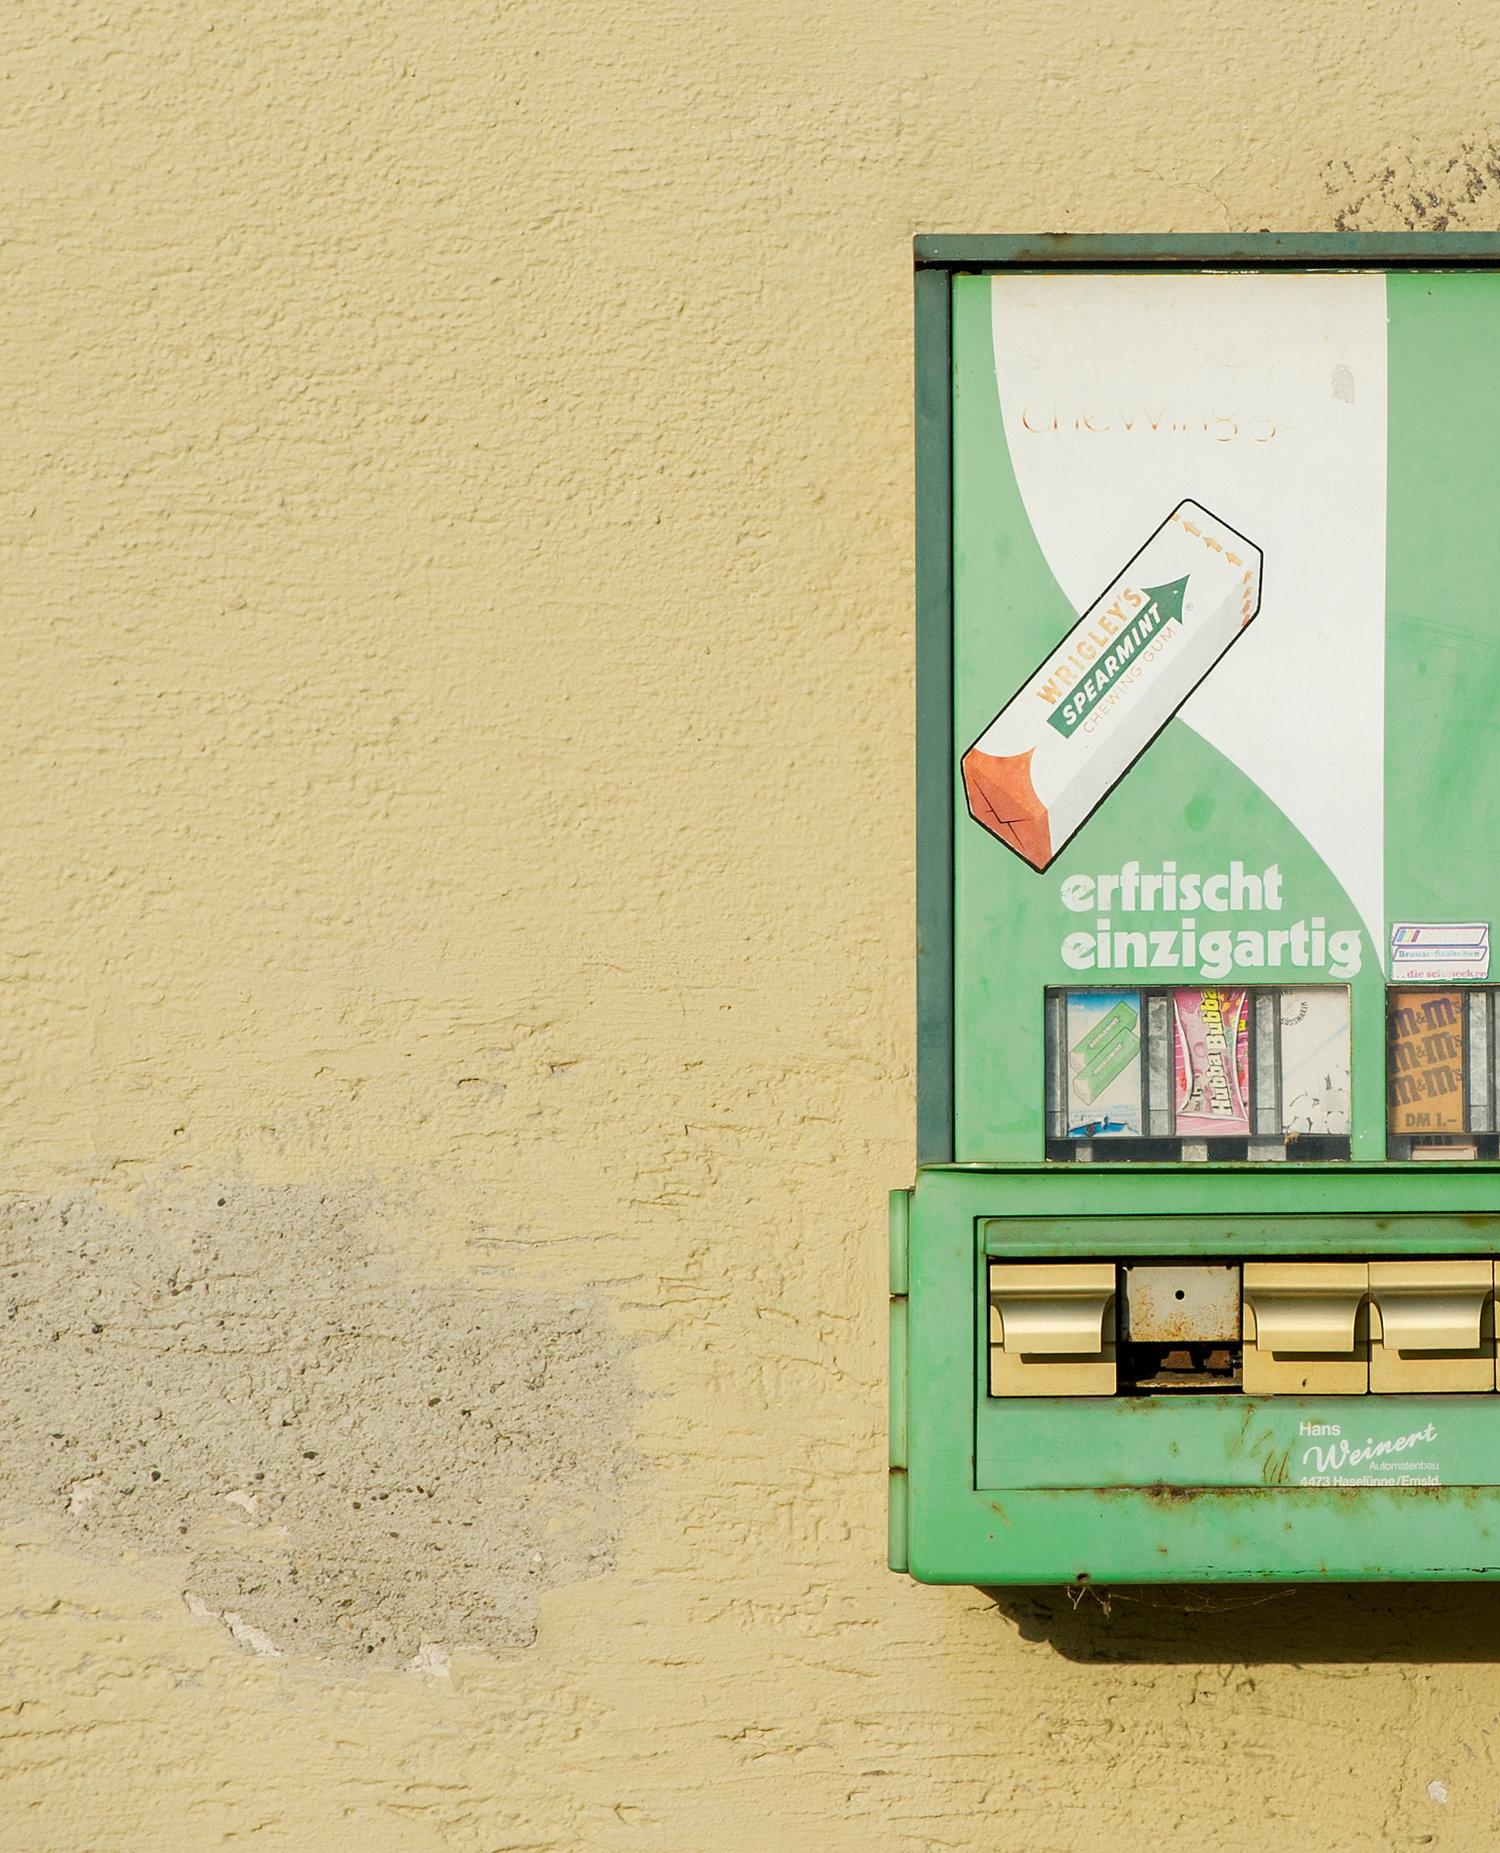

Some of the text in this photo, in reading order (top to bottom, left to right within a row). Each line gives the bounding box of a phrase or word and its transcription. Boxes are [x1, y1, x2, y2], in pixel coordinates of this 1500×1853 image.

[1035, 587, 1142, 705] WRIGLEY'S
[1061, 601, 1163, 726] SPEARMINT
[1082, 625, 1176, 735] CHEWING GUM
[1060, 861, 1283, 912] erfrischt
[1061, 917, 1362, 979] einzigartig
[1200, 988, 1226, 1051] Bubba
[1205, 1052, 1233, 1116] Hubba
[1405, 1112, 1431, 1128] DM
[1299, 1422, 1341, 1436] Hans
[1303, 1423, 1437, 1473] Weinert
[1301, 1476, 1330, 1487] 4473
[1369, 1461, 1440, 1471] Automatenbau
